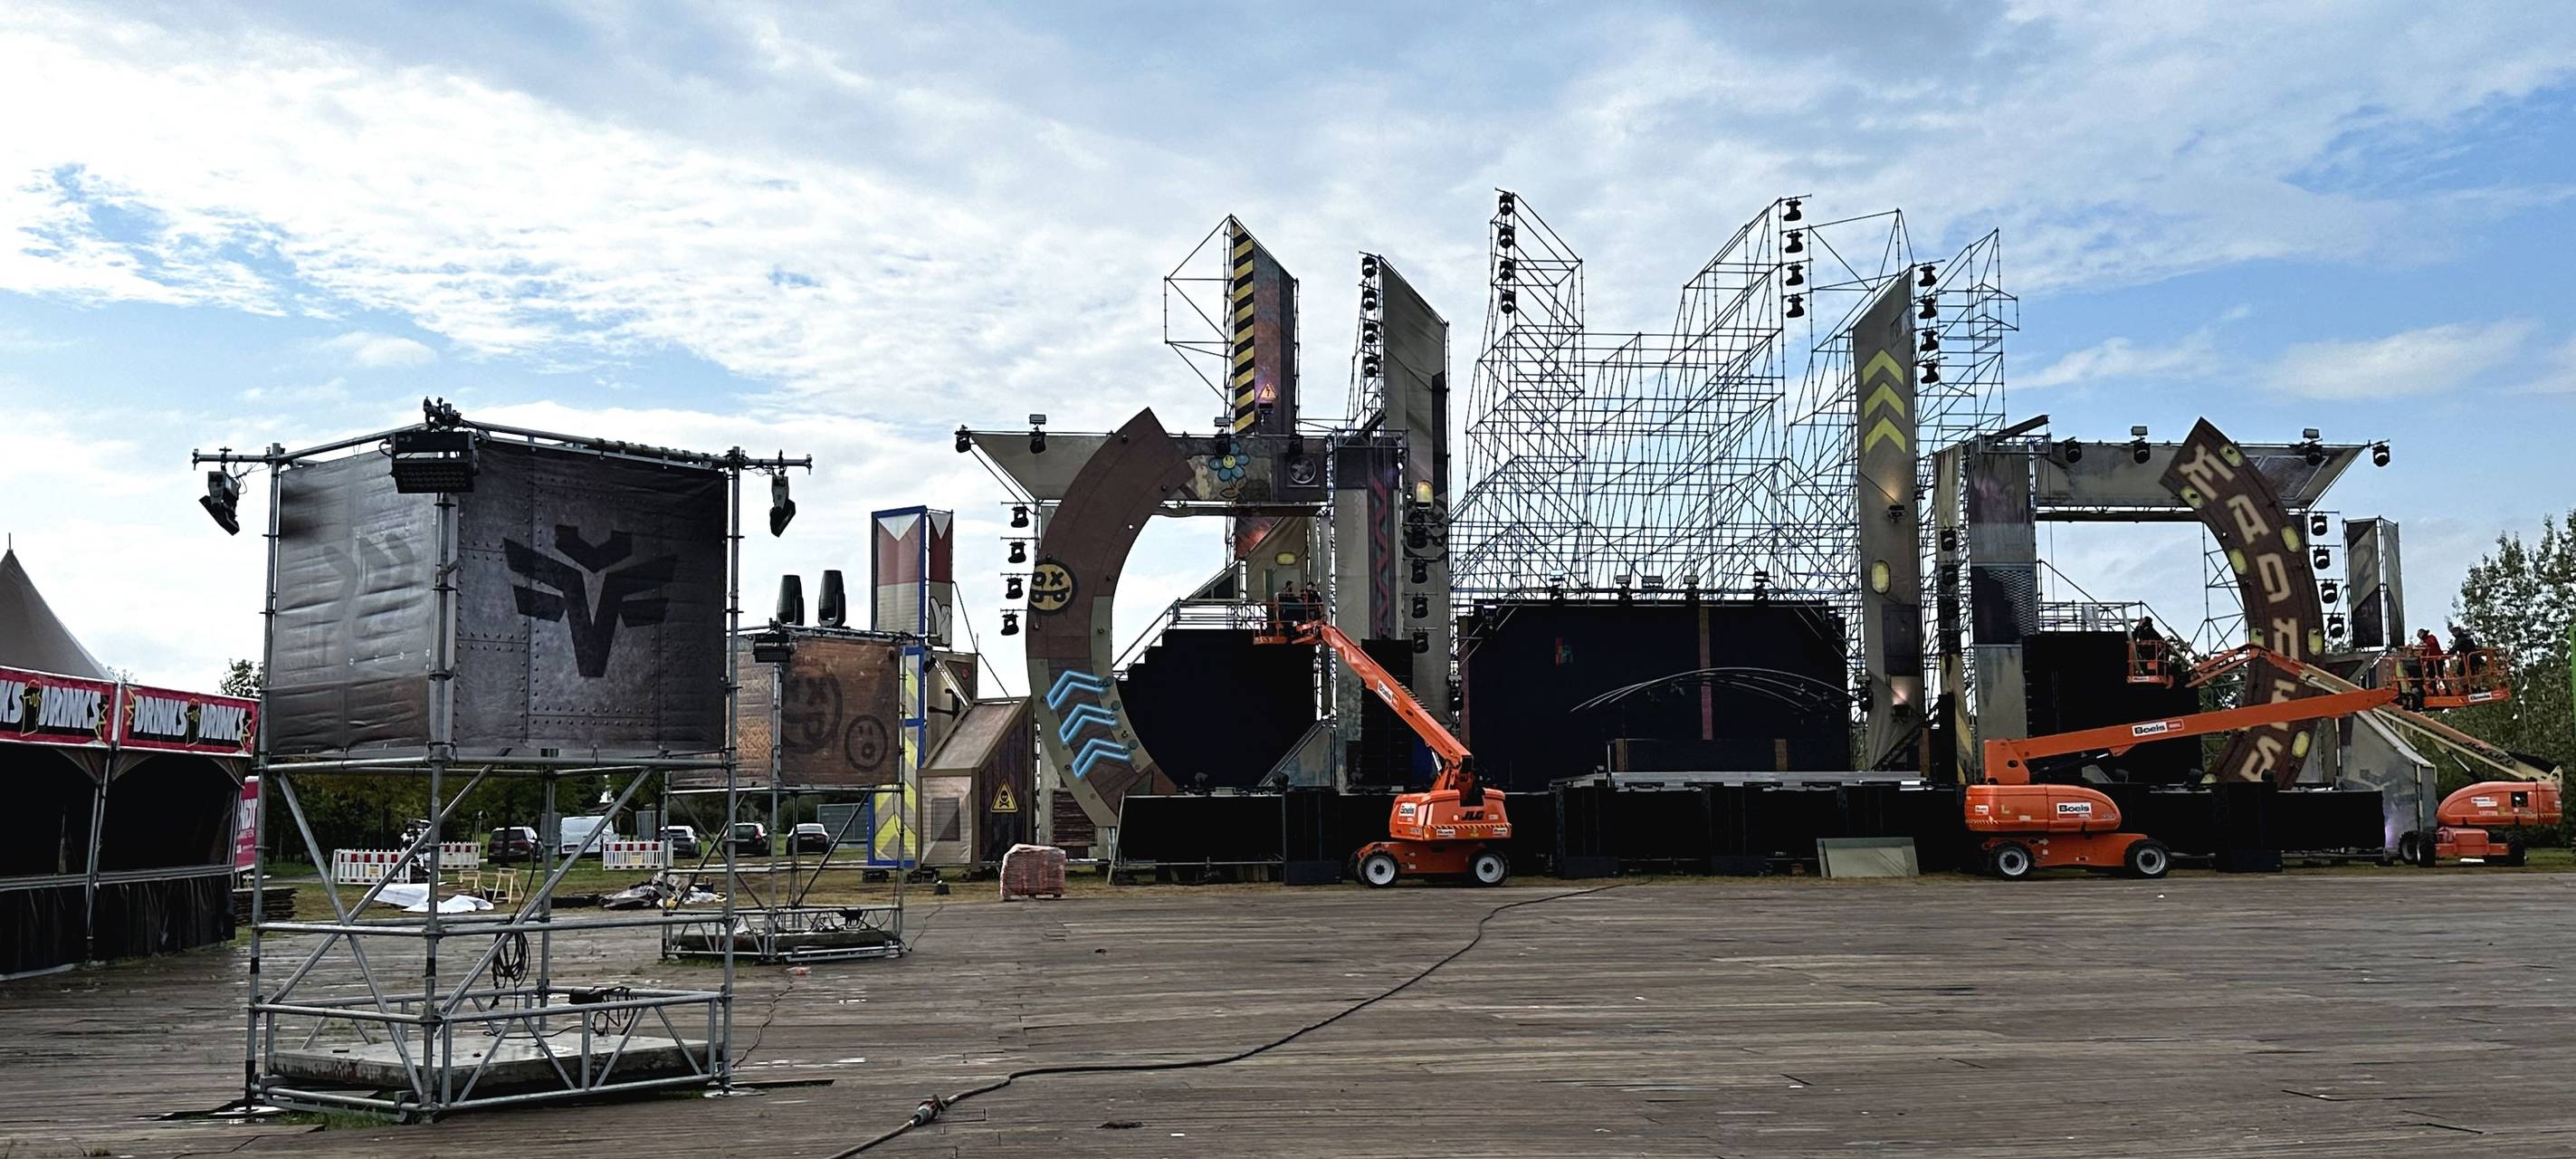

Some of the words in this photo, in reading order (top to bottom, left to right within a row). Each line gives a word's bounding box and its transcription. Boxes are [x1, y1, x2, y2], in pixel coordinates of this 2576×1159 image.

[38, 685, 101, 729] DRINKS
[133, 694, 189, 736] DRINKS
[199, 703, 246, 741] DRINKS
[2134, 723, 2166, 734] Boels
[1462, 810, 1484, 820] JLG
